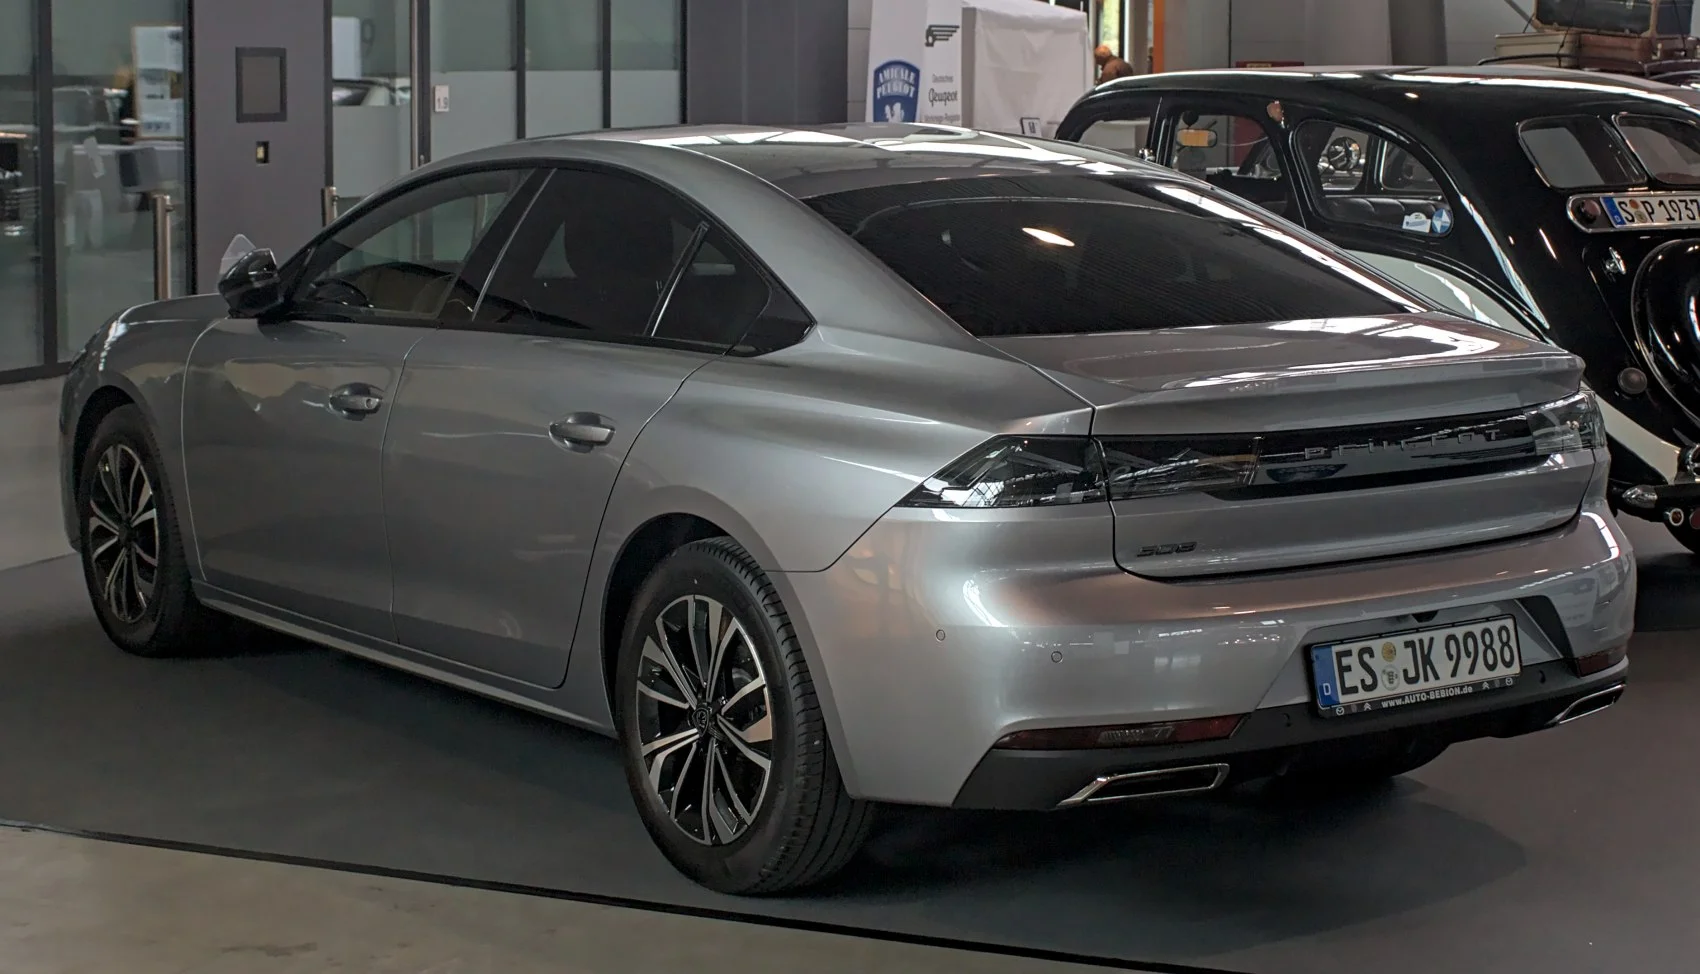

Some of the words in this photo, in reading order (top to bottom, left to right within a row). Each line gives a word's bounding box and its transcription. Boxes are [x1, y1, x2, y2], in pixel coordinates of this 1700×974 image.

[876, 81, 915, 99] PEUGEOT
[1618, 201, 1635, 223] S
[1642, 200, 1655, 222] P
[1335, 645, 1379, 696] ES
[1402, 636, 1441, 685] JK
[1444, 625, 1515, 679] 9988
[1322, 682, 1332, 696] D
[1381, 685, 1473, 709] www.AUTO-BEBION.de
